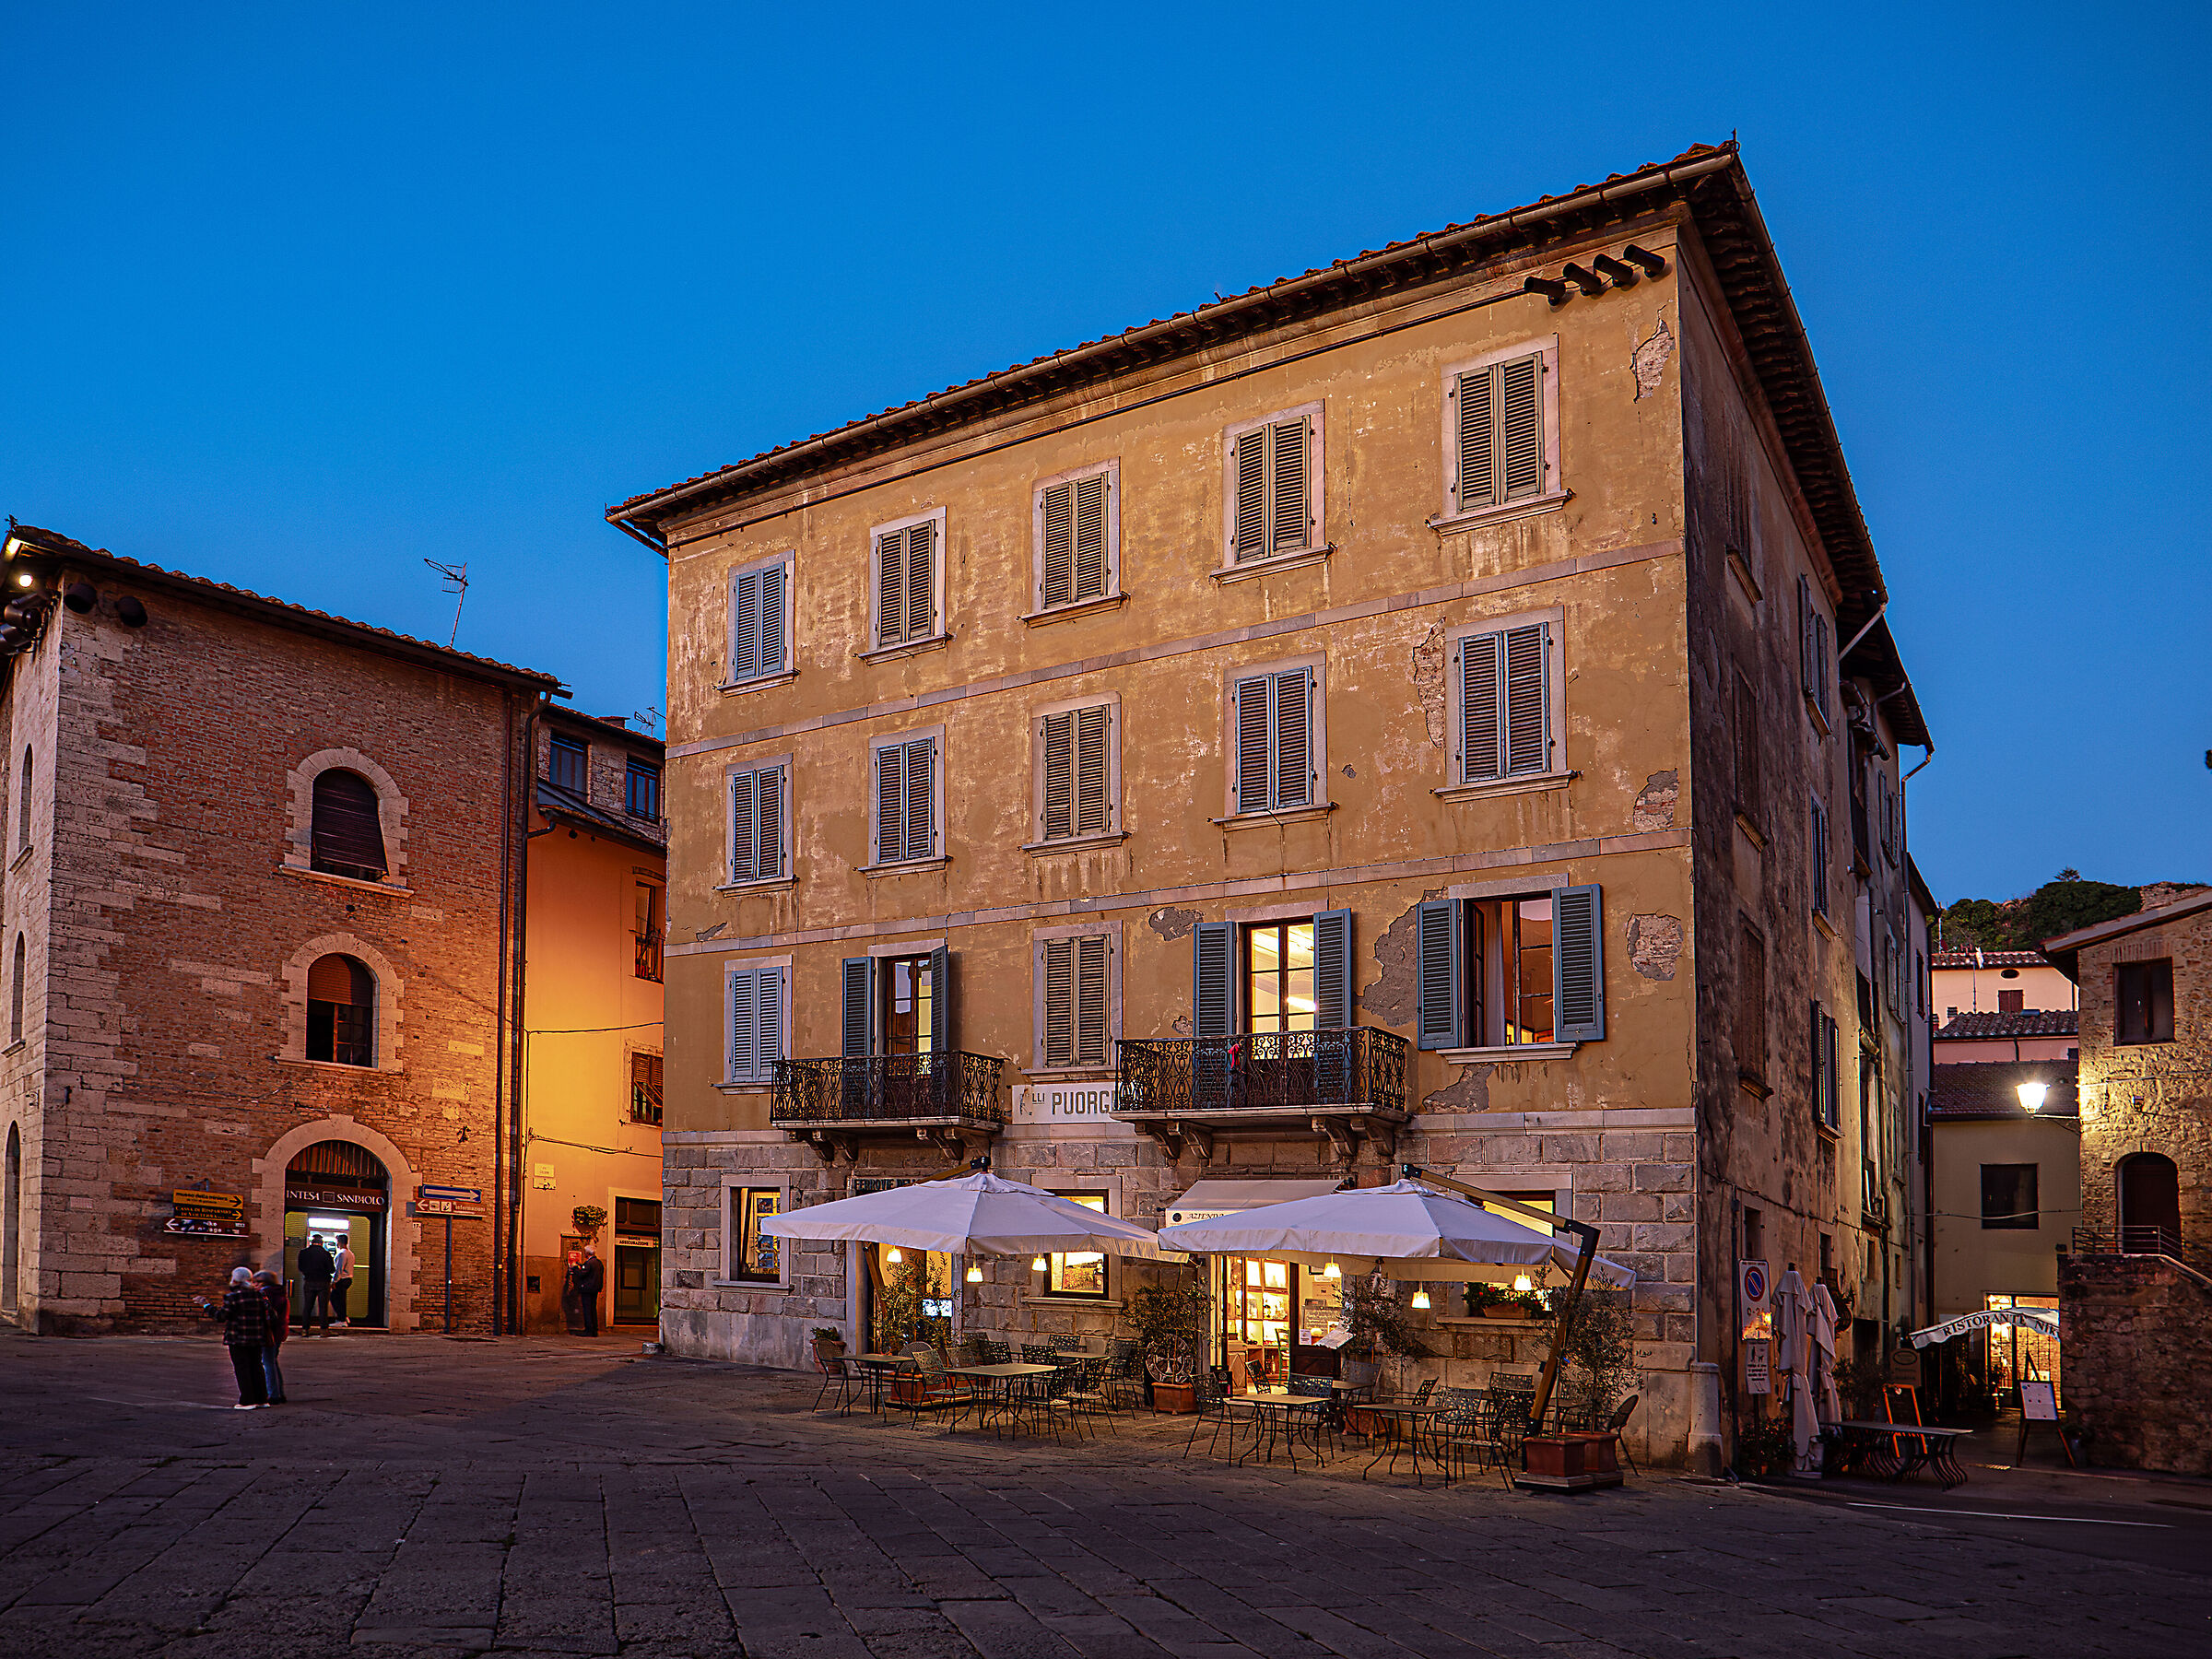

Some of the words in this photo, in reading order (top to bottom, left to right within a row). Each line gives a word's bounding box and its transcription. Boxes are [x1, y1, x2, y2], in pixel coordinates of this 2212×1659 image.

[1052, 1090, 1115, 1114] PUORG
[854, 1179, 894, 1191] FERROVIE
[287, 1190, 320, 1201] INTESA
[336, 1194, 384, 1206] SANPAOLO
[1942, 1313, 2027, 1336] RISTORANTE
